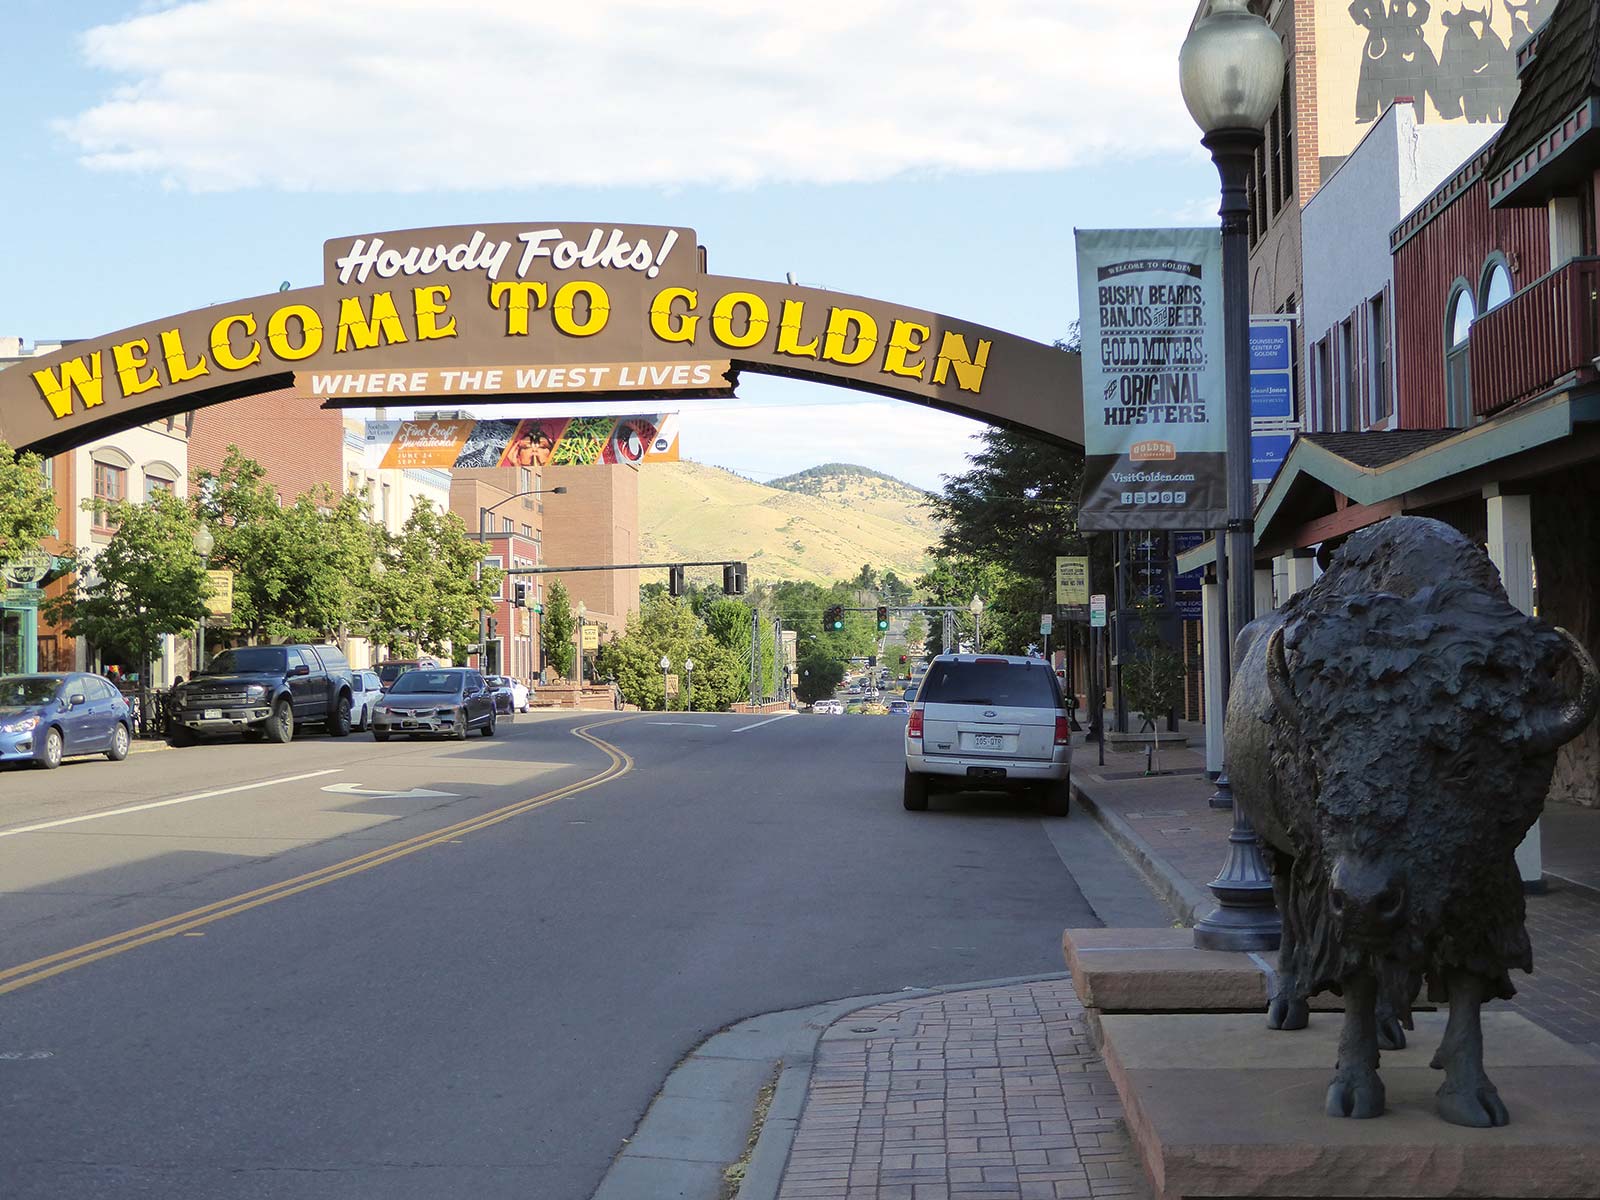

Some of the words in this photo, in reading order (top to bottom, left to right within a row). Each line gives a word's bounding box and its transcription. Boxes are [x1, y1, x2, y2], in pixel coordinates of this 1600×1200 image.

[336, 230, 512, 283] Howdy
[517, 228, 680, 279] Folks!
[1108, 263, 1144, 274] WELCOME
[1162, 263, 1192, 273] GOLDEN
[1098, 286, 1144, 306] BUSHY
[1149, 285, 1206, 307] BEARDS,
[1100, 306, 1153, 328] BANJOS
[1168, 306, 1207, 327] BEER.
[32, 285, 458, 419] WELCOME
[490, 280, 611, 337] TO
[650, 287, 993, 394] GOLDEN
[1101, 337, 1140, 366] GOLD
[311, 373, 428, 395] WHERE
[440, 370, 503, 391] THE
[516, 367, 610, 389] WEST
[618, 365, 712, 386] LIVES
[1120, 373, 1206, 406] ORIGINAL
[1103, 405, 1210, 426] HIPSTERS.
[402, 422, 426, 437] Fine
[427, 422, 458, 440] Craft
[397, 436, 458, 451] Invitational
[1133, 443, 1172, 454] GOLDEN
[1111, 472, 1195, 482] VisitGolden.com
